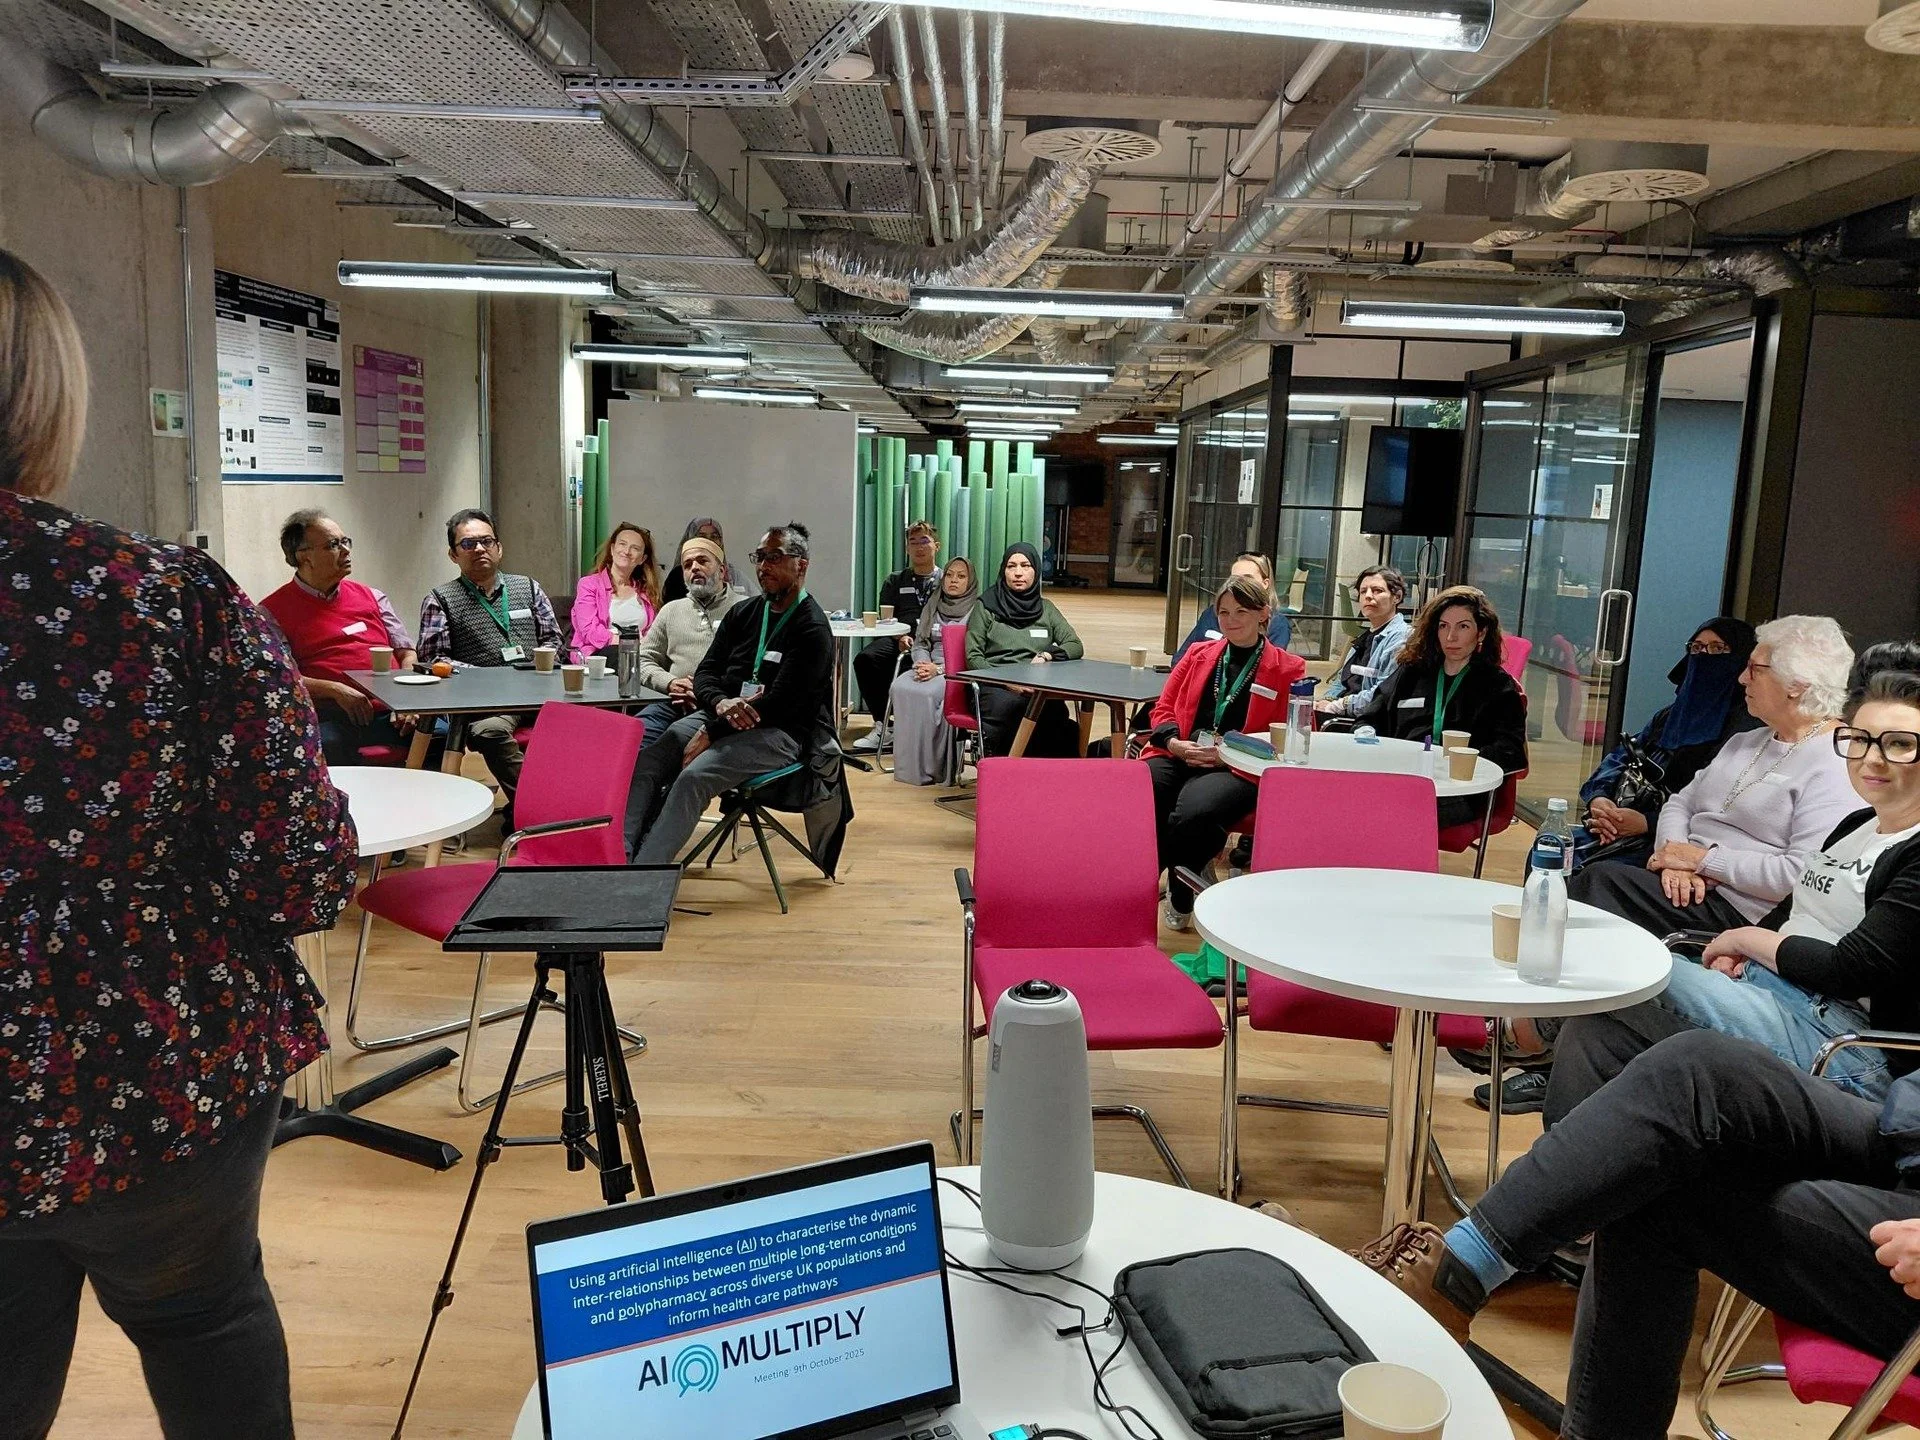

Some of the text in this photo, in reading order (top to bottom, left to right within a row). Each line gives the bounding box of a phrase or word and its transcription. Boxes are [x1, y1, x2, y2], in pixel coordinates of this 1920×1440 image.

[1801, 869, 1835, 894] SENSE
[592, 1056, 610, 1102] SKERELL
[569, 1202, 918, 1290] Using artificial intelligence (AI) to characterise the dynamic
[573, 1220, 917, 1309] inter-relationships between multiple long-term conditions
[590, 1240, 906, 1325] and polypharmacy across diverse UK populations and
[668, 1276, 839, 1326] inform health care pathways
[638, 1306, 866, 1392] AI MULTIPLY
[793, 1363, 808, 1374] 9th
[809, 1355, 843, 1370] October
[844, 1348, 865, 1360] 2025
